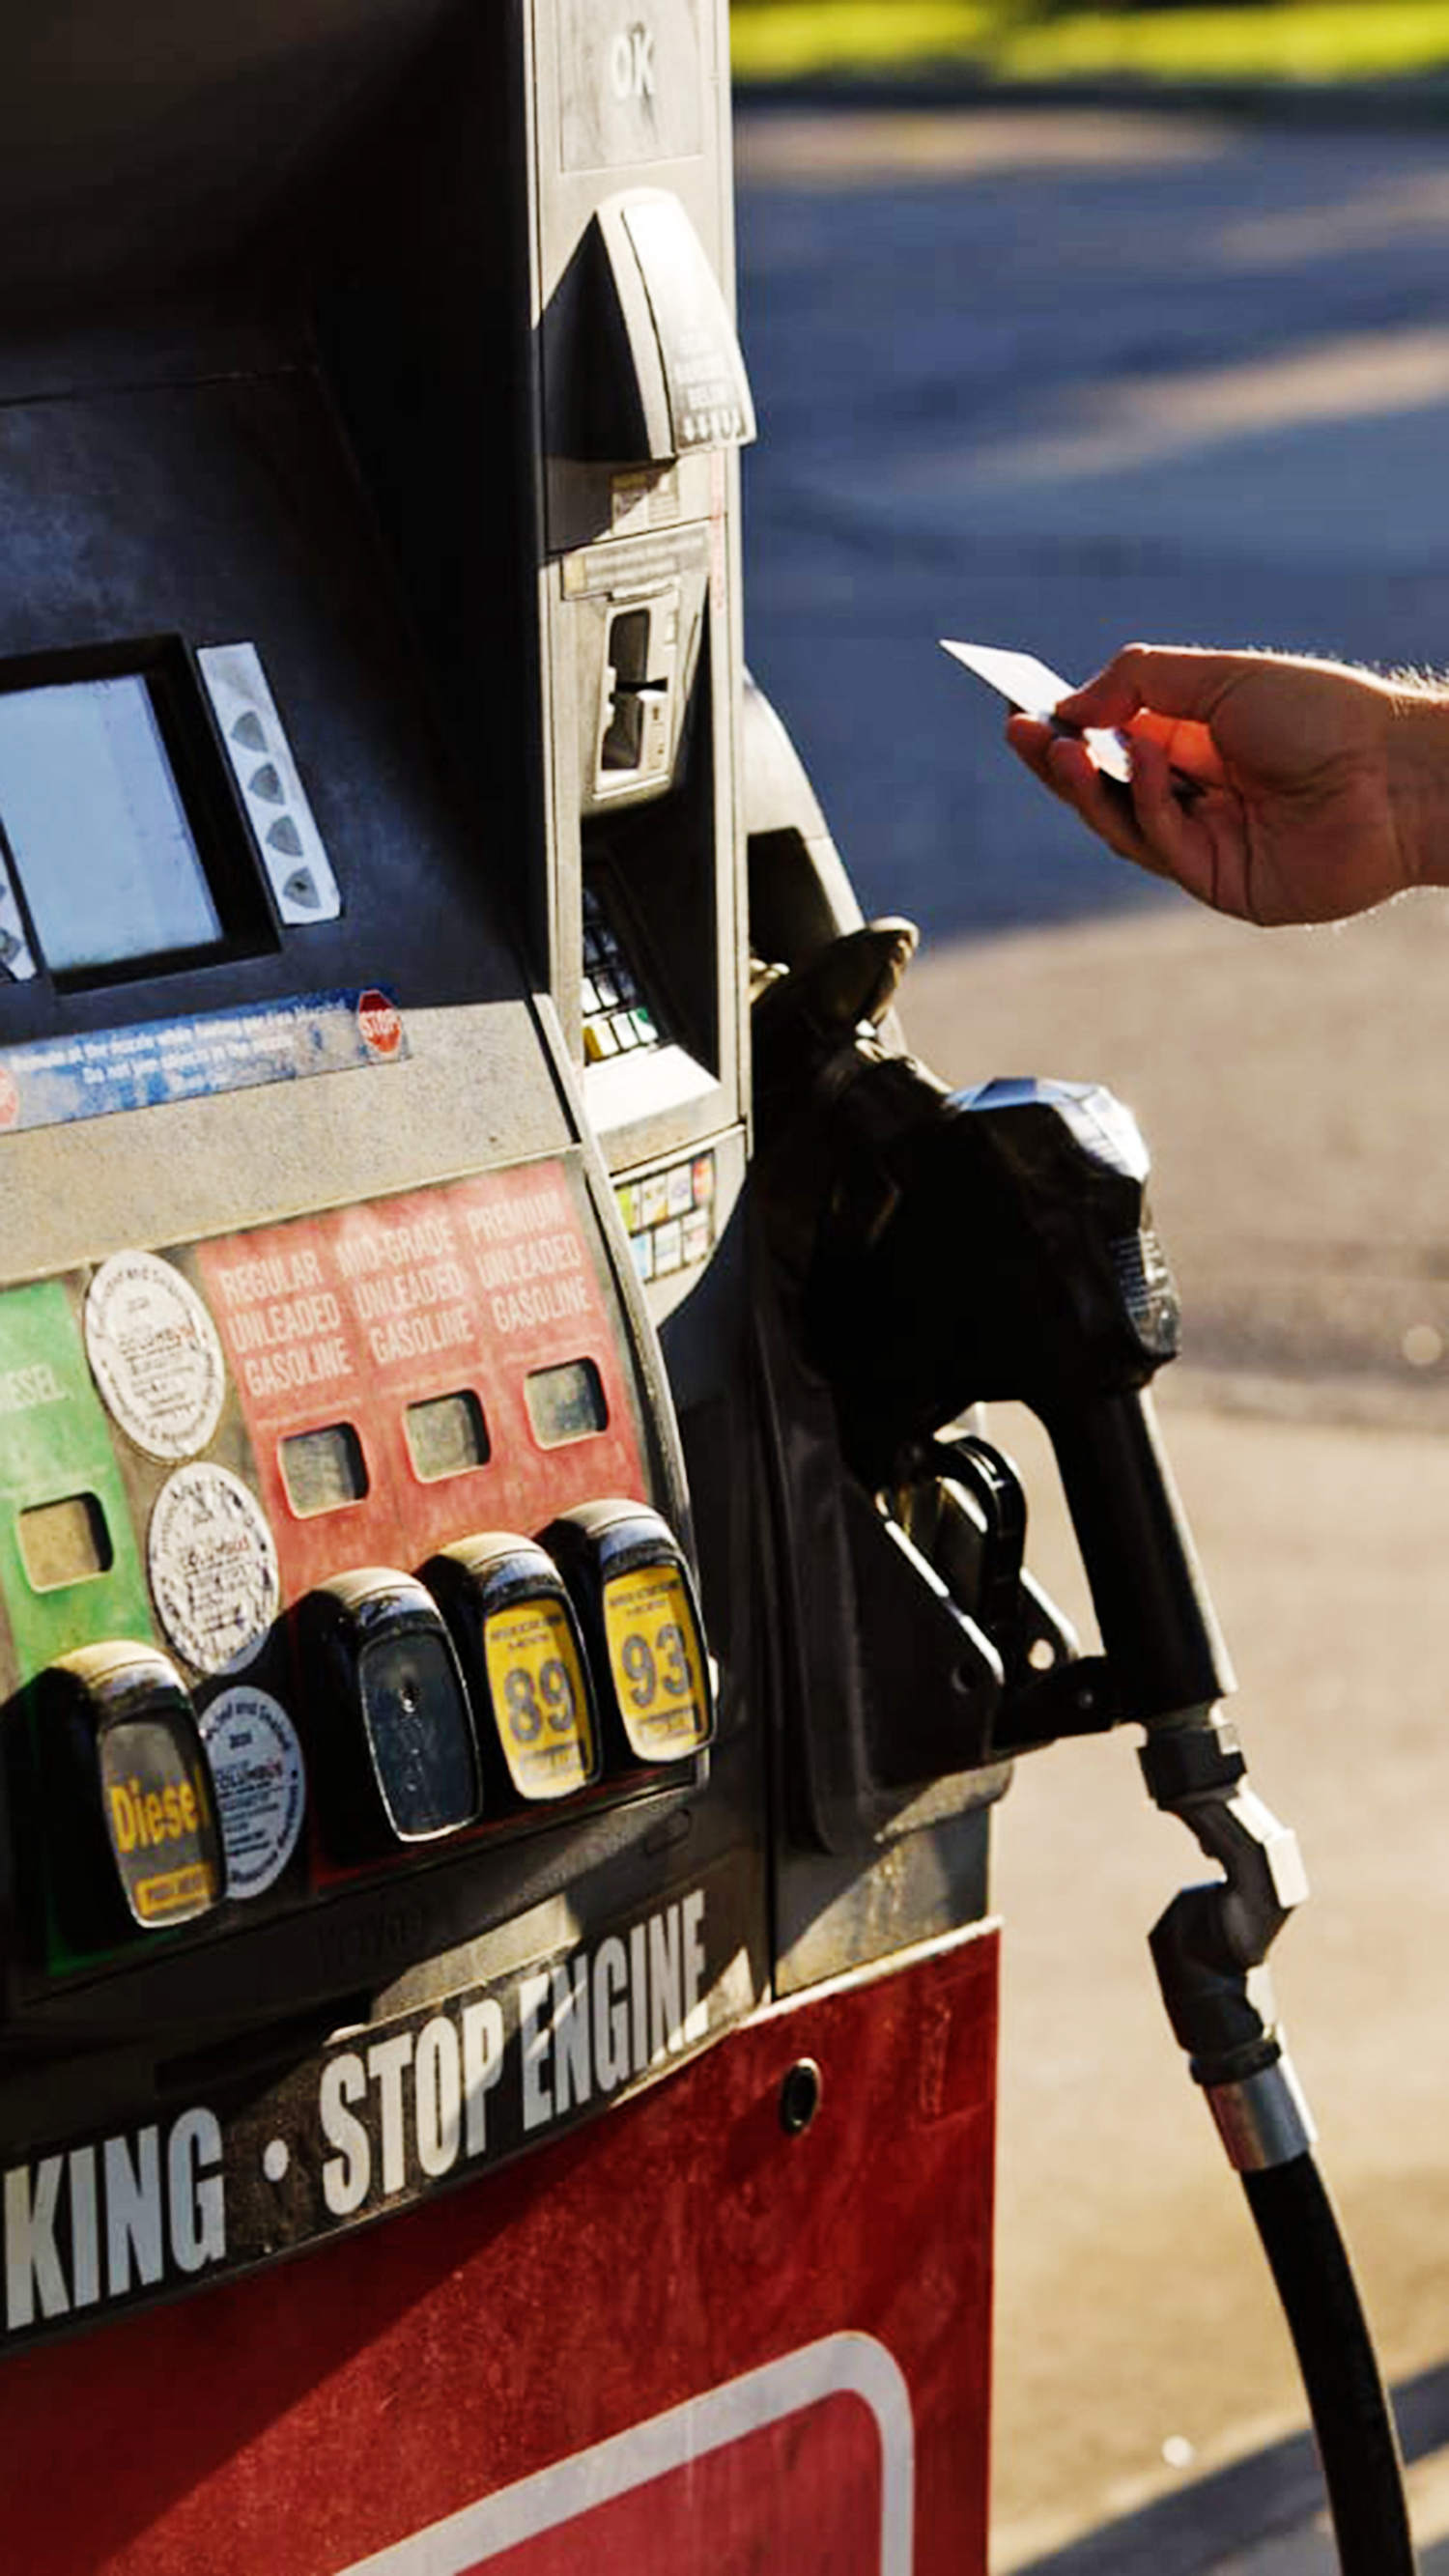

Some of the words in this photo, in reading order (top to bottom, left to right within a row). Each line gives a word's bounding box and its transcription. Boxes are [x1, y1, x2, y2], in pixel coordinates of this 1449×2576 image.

[611, 29, 656, 98] OK
[335, 1215, 457, 1278] MID-GRADE
[465, 1190, 567, 1244] PREMIUM
[219, 1251, 325, 1306] REGULAR
[353, 1260, 465, 1320] UNLEADED
[479, 1232, 581, 1290] UNLEADED
[227, 1292, 342, 1352] UNLEADED
[369, 1305, 474, 1366] GASOLINE
[491, 1276, 591, 1334] GASOLINE
[243, 1337, 353, 1398] GASOLINE
[621, 1623, 692, 1709] 93
[503, 1658, 576, 1743] 89
[4, 2107, 226, 2331] KING
[319, 1998, 505, 2216] STOP
[519, 1890, 709, 2131] ENGINE
